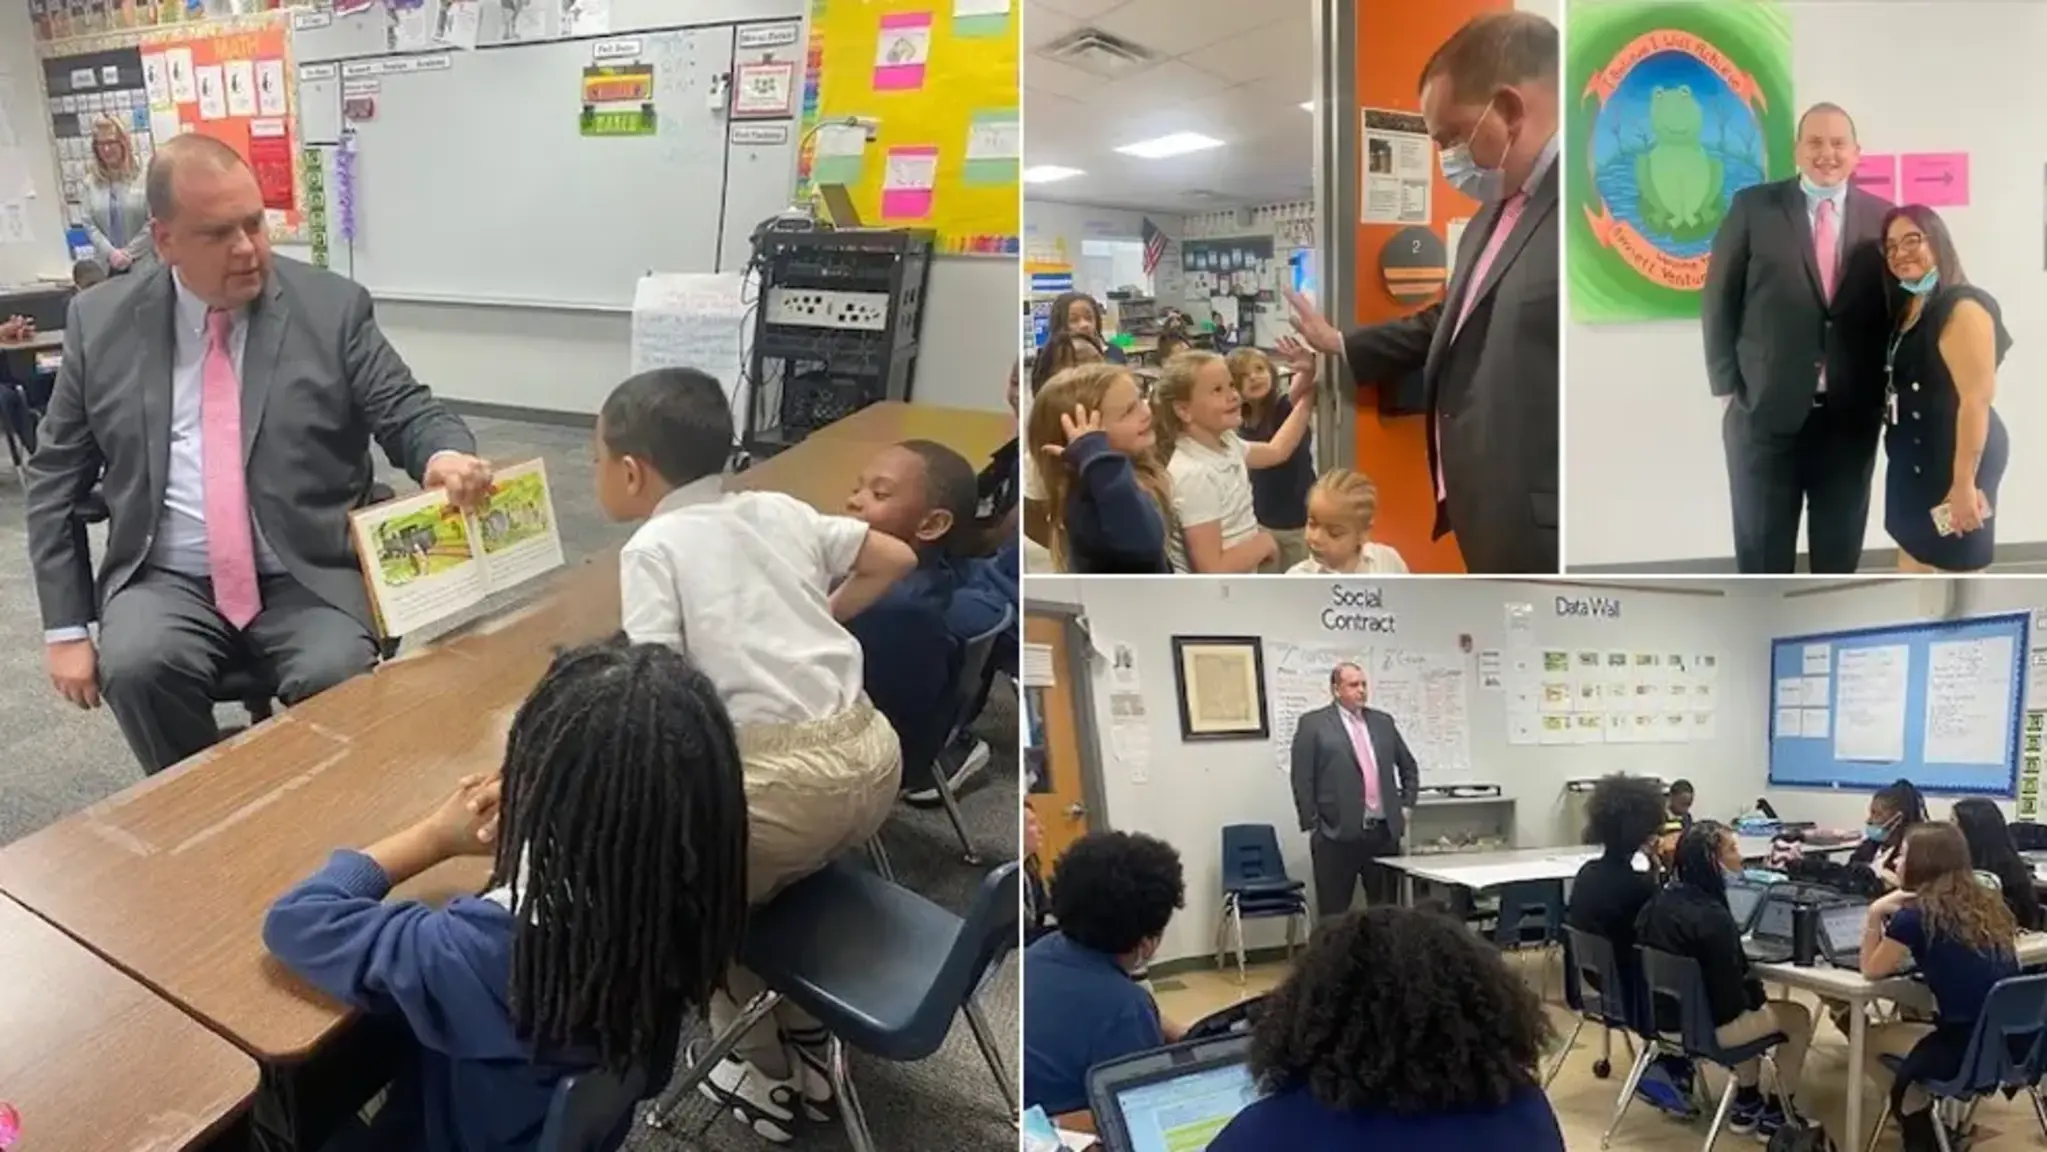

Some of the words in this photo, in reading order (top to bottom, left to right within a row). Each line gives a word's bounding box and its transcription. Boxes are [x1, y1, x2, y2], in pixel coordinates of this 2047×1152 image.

[1651, 36, 1659, 50] I
[1663, 34, 1690, 50] Will
[1695, 43, 1742, 91] Achieve
[1412, 239, 1421, 254] 2
[1332, 584, 1383, 608] Social
[1555, 596, 1588, 617] Data
[1589, 597, 1620, 618] Wall
[1321, 608, 1396, 633] Contract
